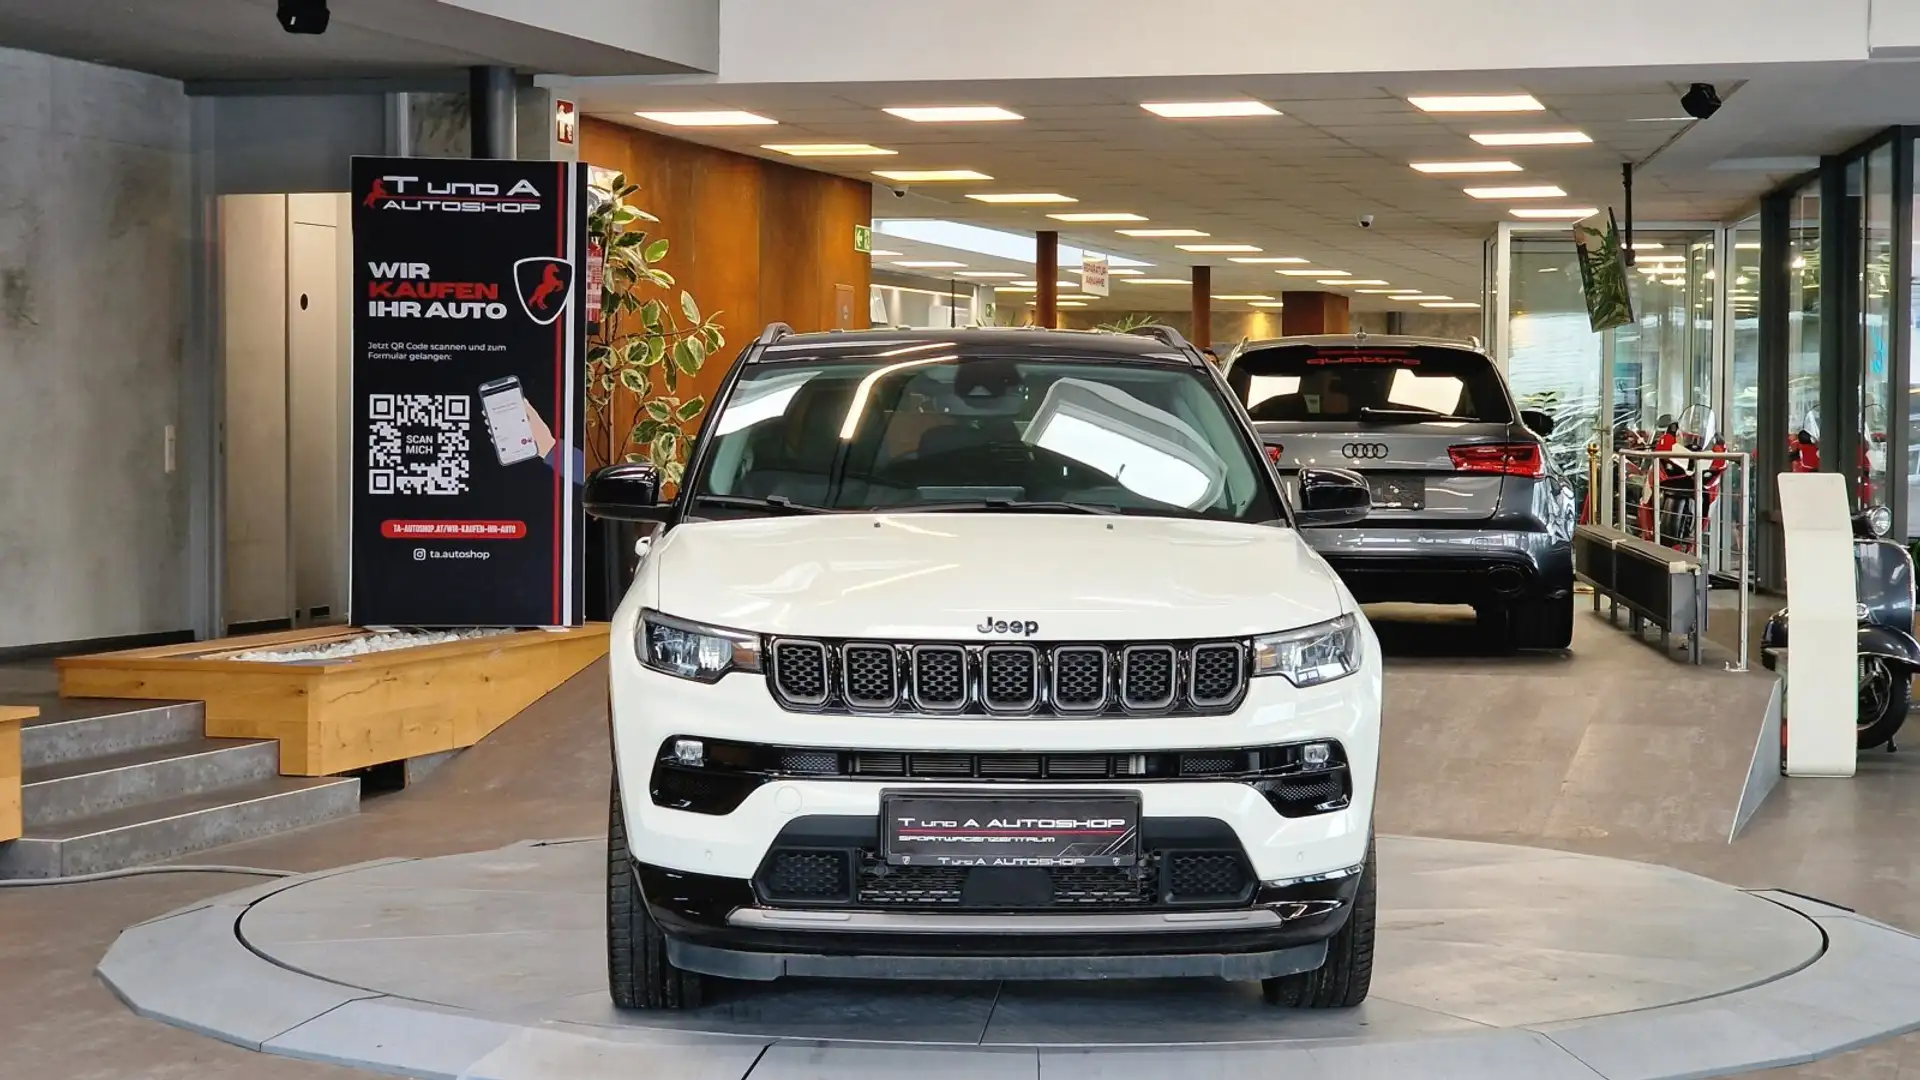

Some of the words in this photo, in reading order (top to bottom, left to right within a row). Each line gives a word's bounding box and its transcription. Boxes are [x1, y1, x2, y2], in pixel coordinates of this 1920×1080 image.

[383, 175, 419, 193] T
[506, 179, 542, 197] A
[383, 200, 541, 213] AUTOSHOP
[368, 262, 430, 279] WIR
[368, 282, 498, 299] KAUFEN
[368, 301, 421, 318] IHR
[424, 302, 508, 319] AUTO
[368, 342, 389, 350] Jetzt
[391, 342, 405, 351] QR
[406, 342, 429, 351] Code
[368, 352, 407, 360] Formular
[409, 353, 452, 362] gelangen:
[1306, 357, 1421, 365] quattro
[406, 435, 433, 444] SCAN
[405, 445, 433, 454] MICH
[430, 549, 490, 560] ta.autoshop
[977, 616, 1039, 637] Jeep
[898, 818, 915, 827] T
[963, 818, 980, 828] A
[987, 818, 1126, 828] AUTOSHOP
[937, 857, 951, 865] T
[975, 857, 987, 866] A
[993, 857, 1086, 866] AUTOSHOP
